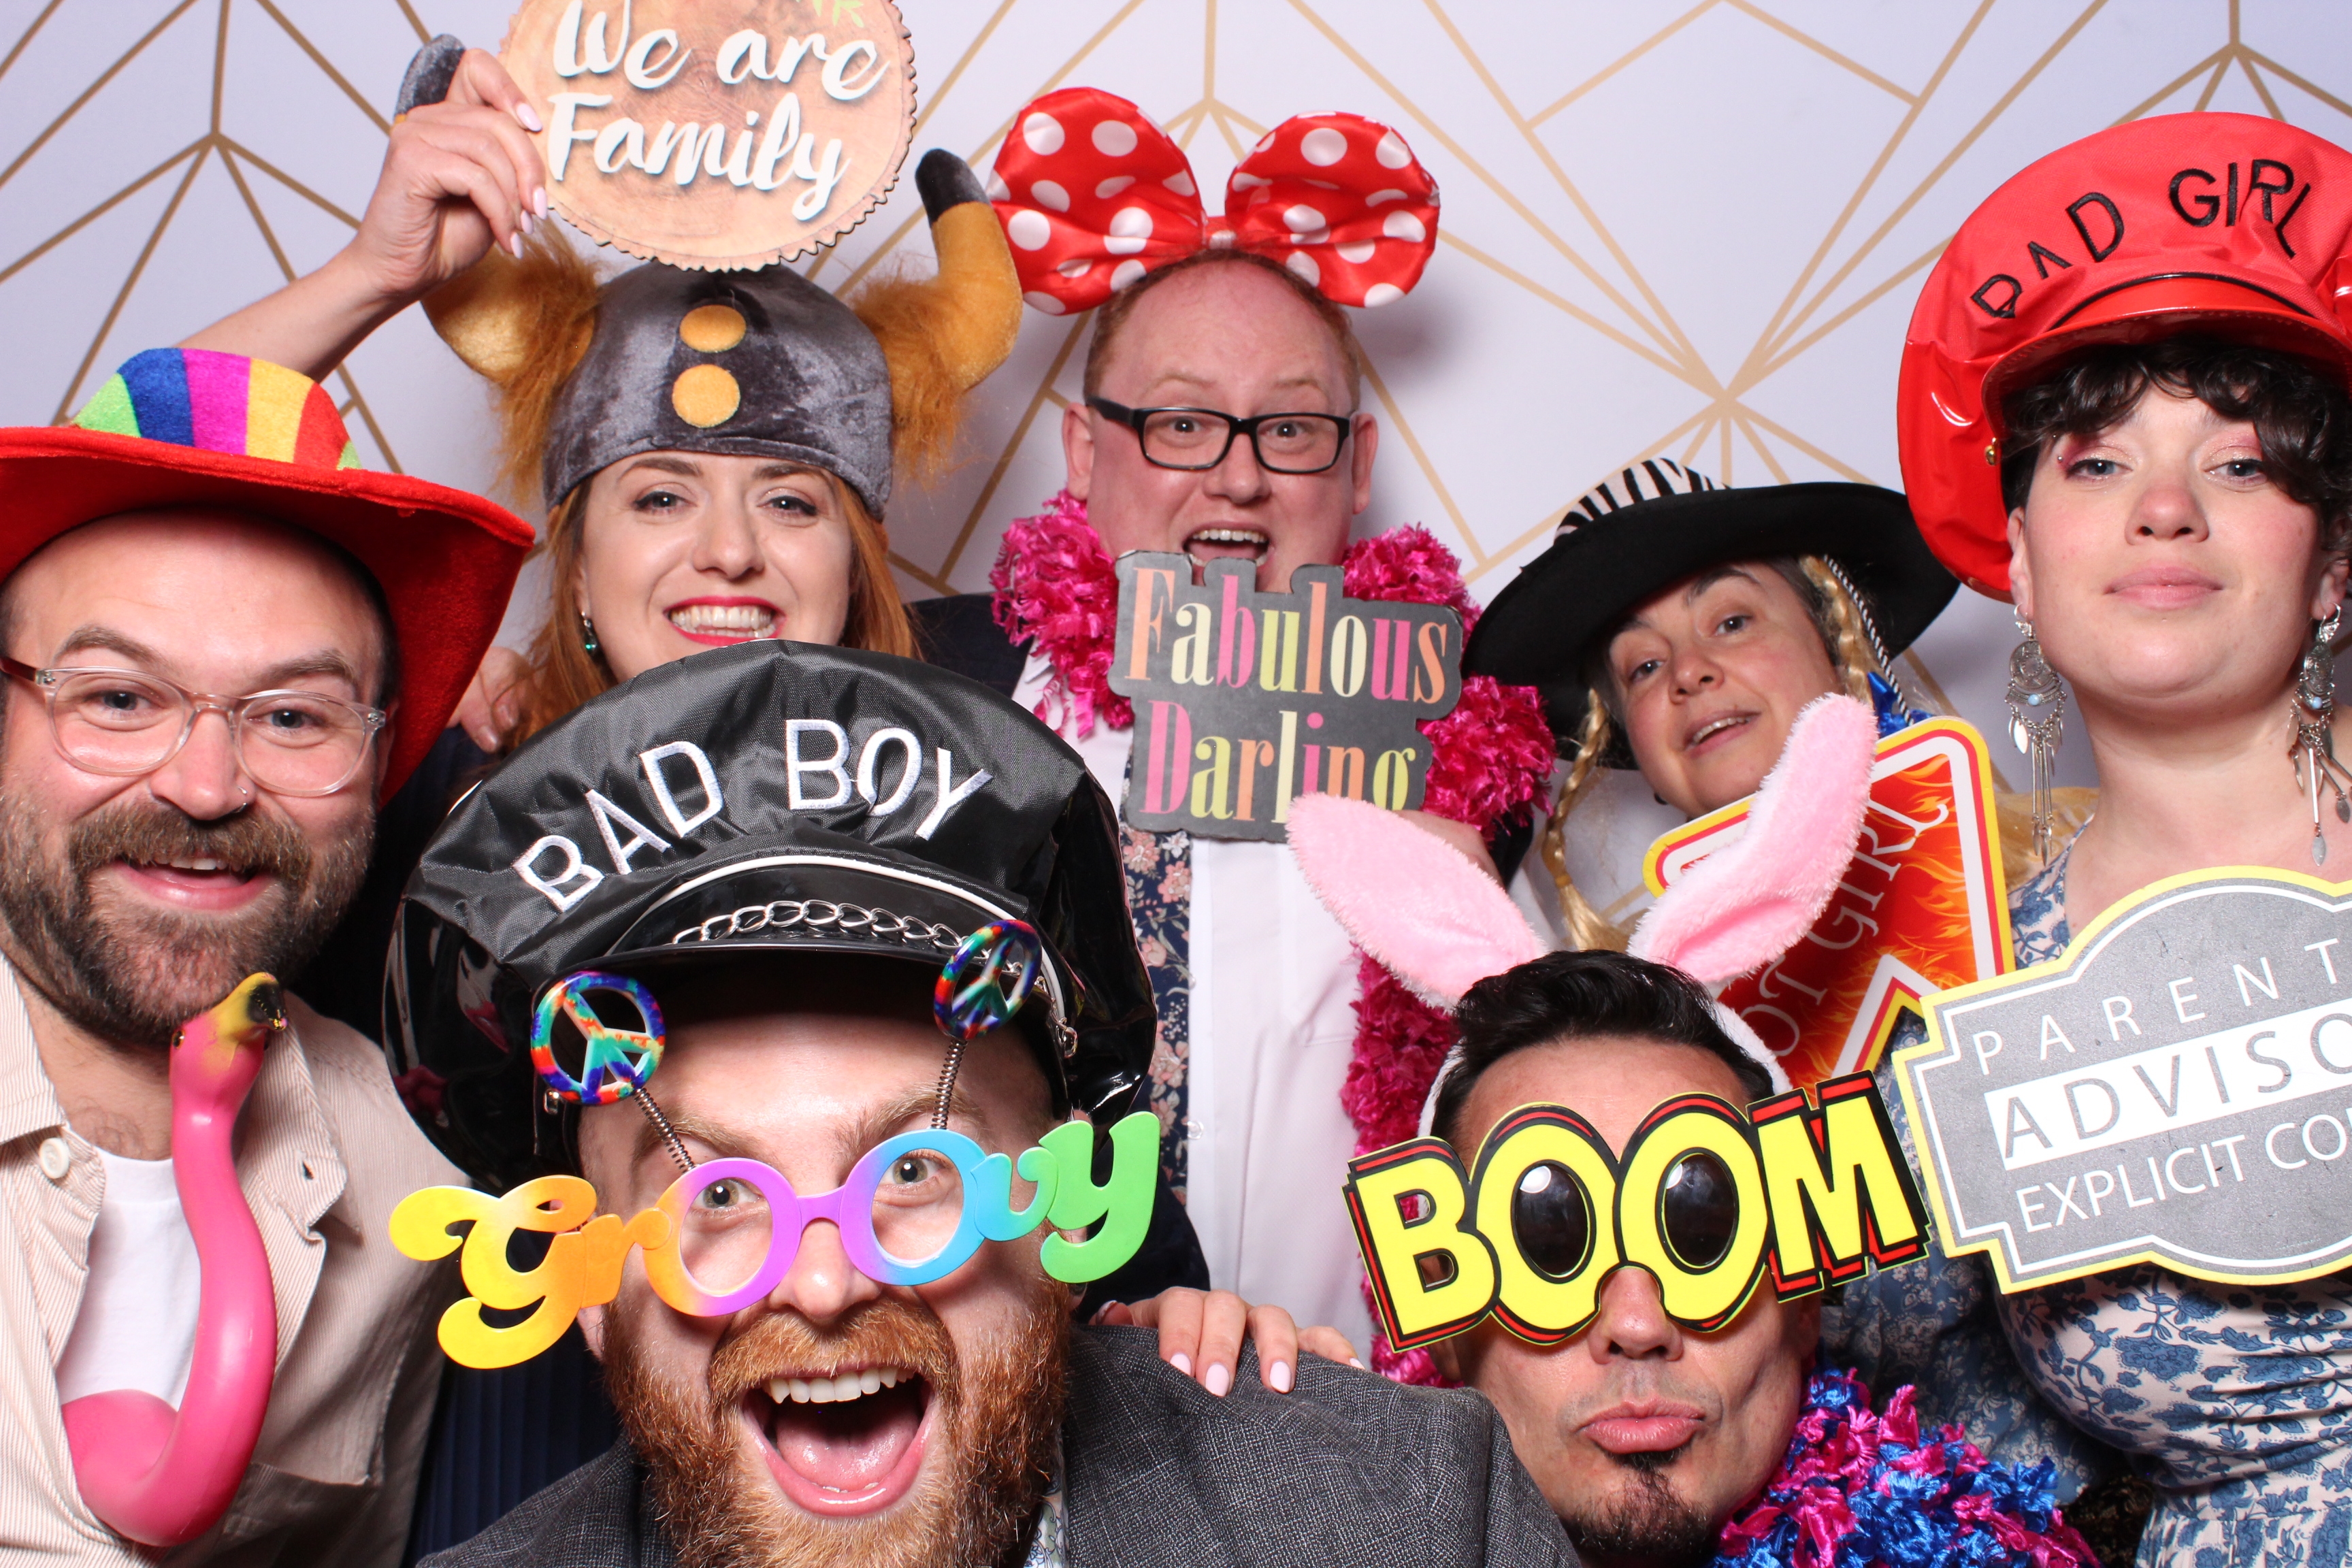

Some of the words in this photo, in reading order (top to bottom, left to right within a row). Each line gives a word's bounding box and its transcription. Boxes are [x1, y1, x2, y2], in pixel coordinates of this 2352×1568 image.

[552, 0, 692, 89] We
[716, 28, 890, 101] are
[546, 92, 851, 222] Family
[2168, 158, 2312, 260] GIRL
[1124, 567, 1448, 704] Fabulous
[512, 740, 724, 913] BAD
[785, 718, 994, 842] BOY
[1739, 953, 1829, 1057] OT
[1343, 1071, 1931, 1352] BOOM
[2015, 1134, 2247, 1233] EXPLICIT
[2264, 1107, 2352, 1171] CO
